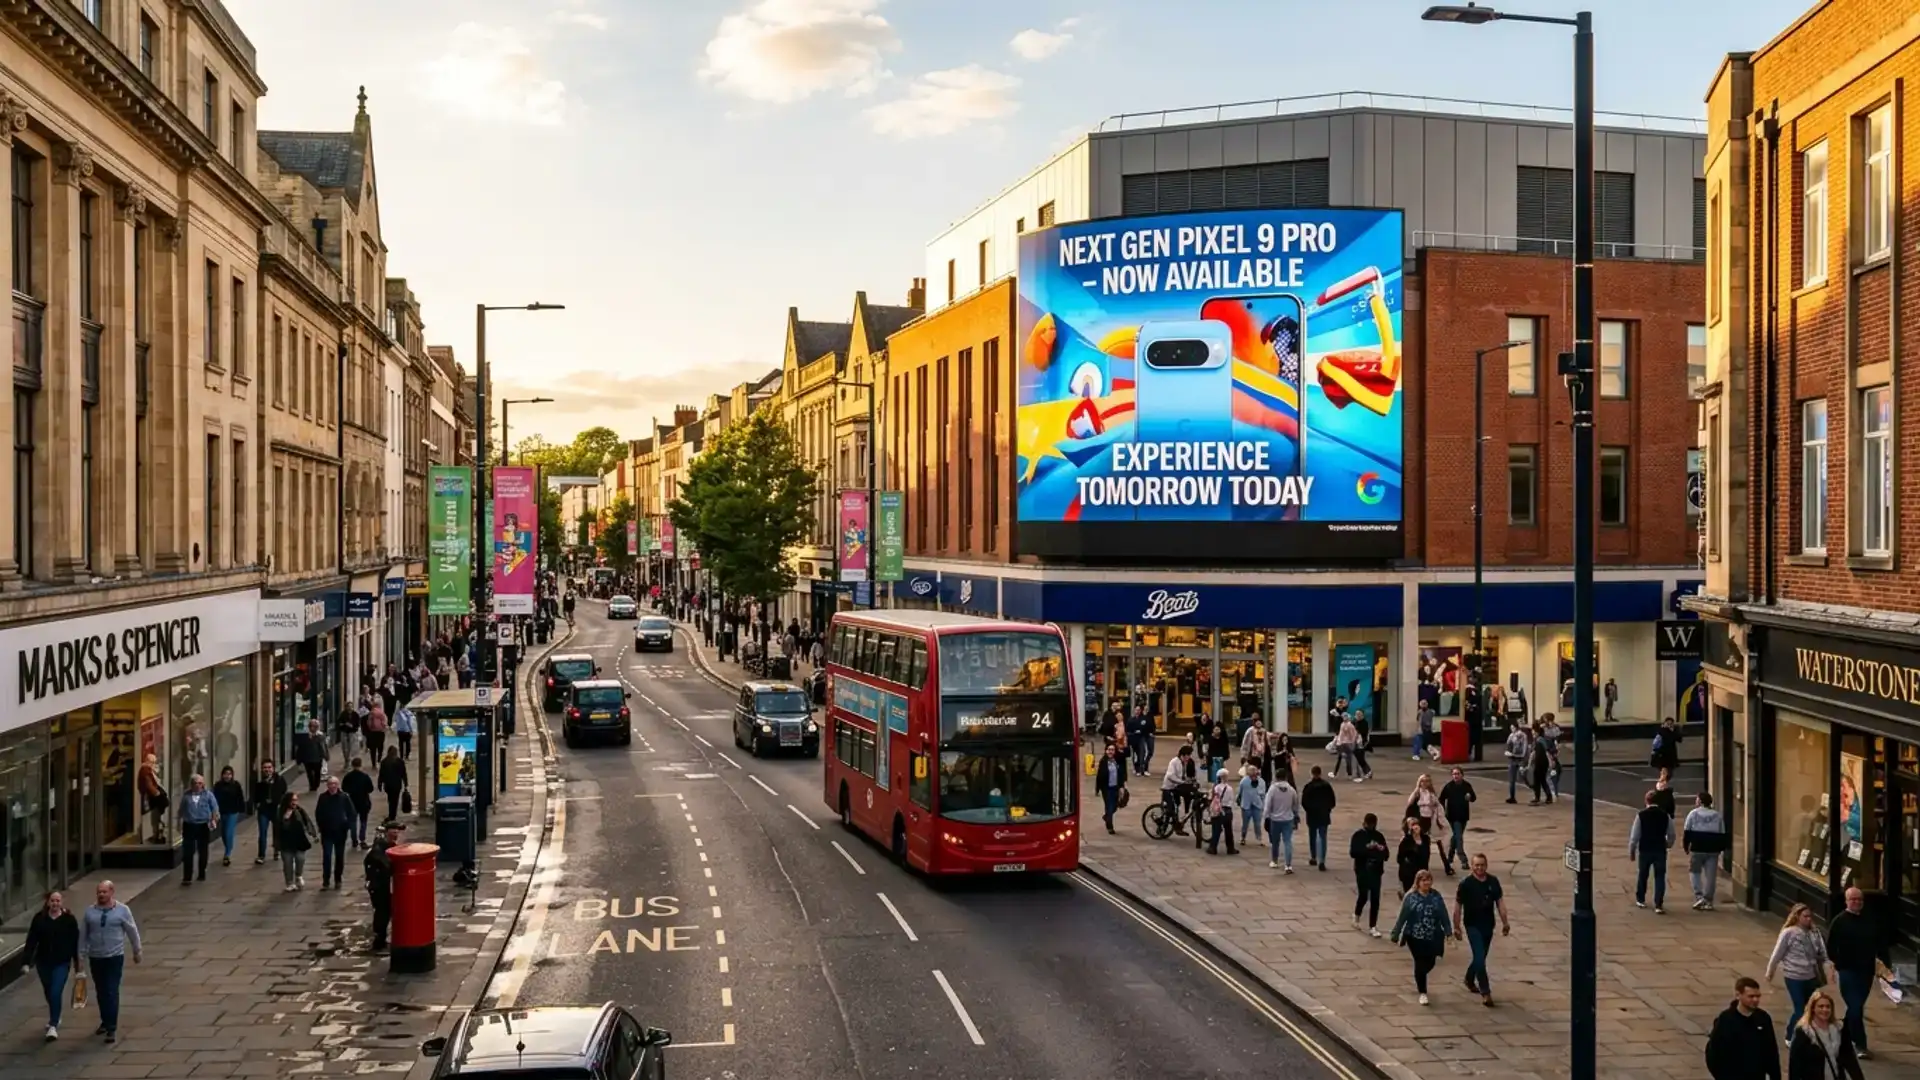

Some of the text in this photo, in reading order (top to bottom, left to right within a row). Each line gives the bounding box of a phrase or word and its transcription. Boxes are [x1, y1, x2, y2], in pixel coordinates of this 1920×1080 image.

[1059, 222, 1336, 266] NEXT GEN PIXEL 9 PRO
[1103, 262, 1160, 295] NOW
[1164, 258, 1304, 291] AVAILABLE
[1112, 441, 1270, 471] EXPERIENCE
[1076, 475, 1315, 506] TOMORROW TODAY
[1142, 590, 1199, 620] Boots
[1663, 626, 1696, 648] W
[18, 616, 200, 705] MARKS & SPENCER
[1031, 712, 1052, 729] 24
[573, 896, 680, 921] BUS
[547, 925, 700, 958] LANE
